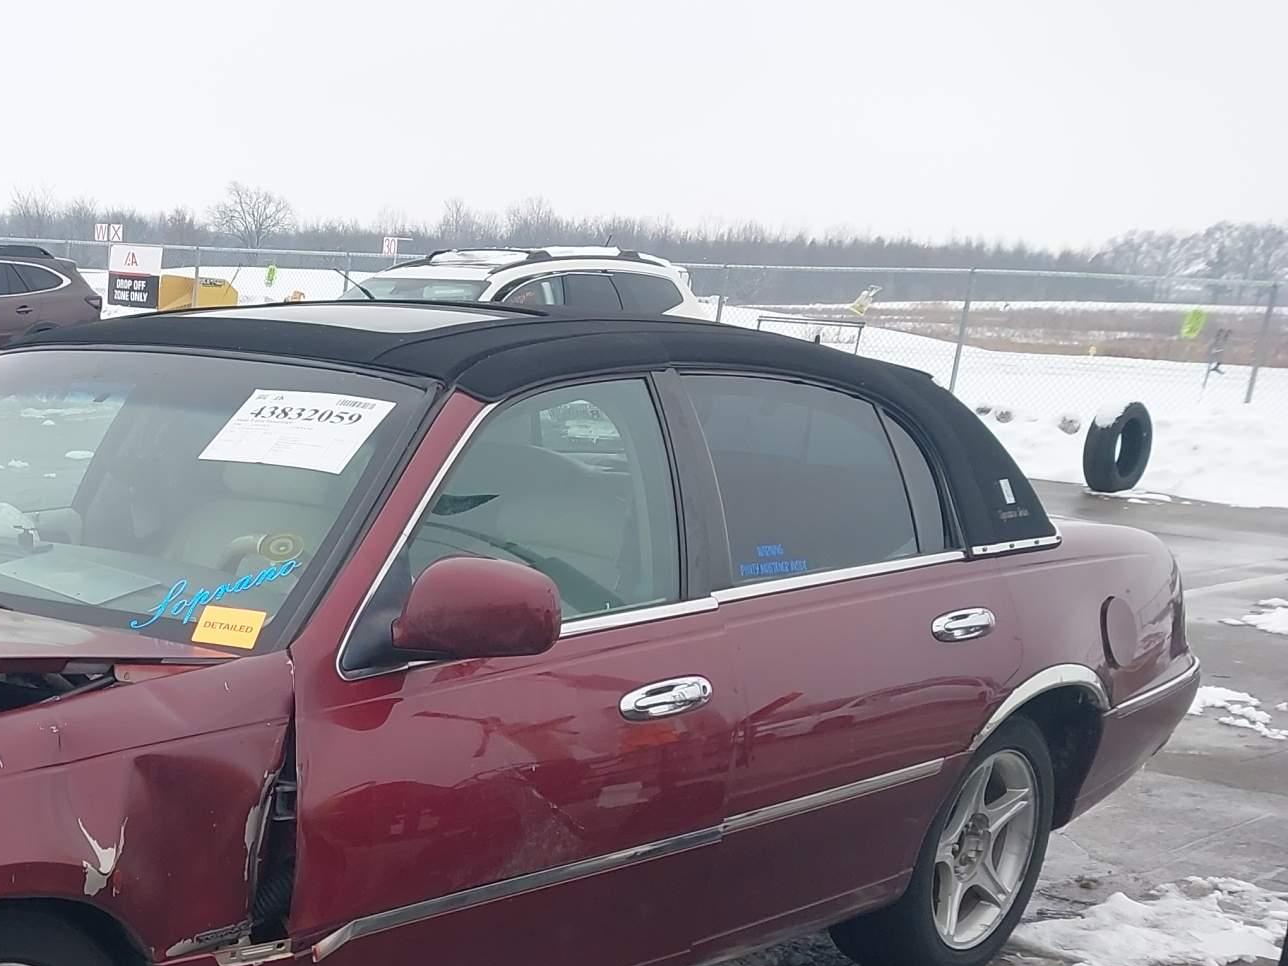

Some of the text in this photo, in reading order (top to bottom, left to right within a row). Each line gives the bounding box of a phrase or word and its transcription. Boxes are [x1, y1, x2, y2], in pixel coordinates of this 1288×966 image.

[96, 225, 121, 240] W X
[116, 278, 147, 290] DROP OFF
[114, 290, 149, 302] ZONE ONLY
[250, 405, 363, 426] 43832059
[130, 559, 302, 629] Soprano
[202, 620, 254, 634] DETAILED
